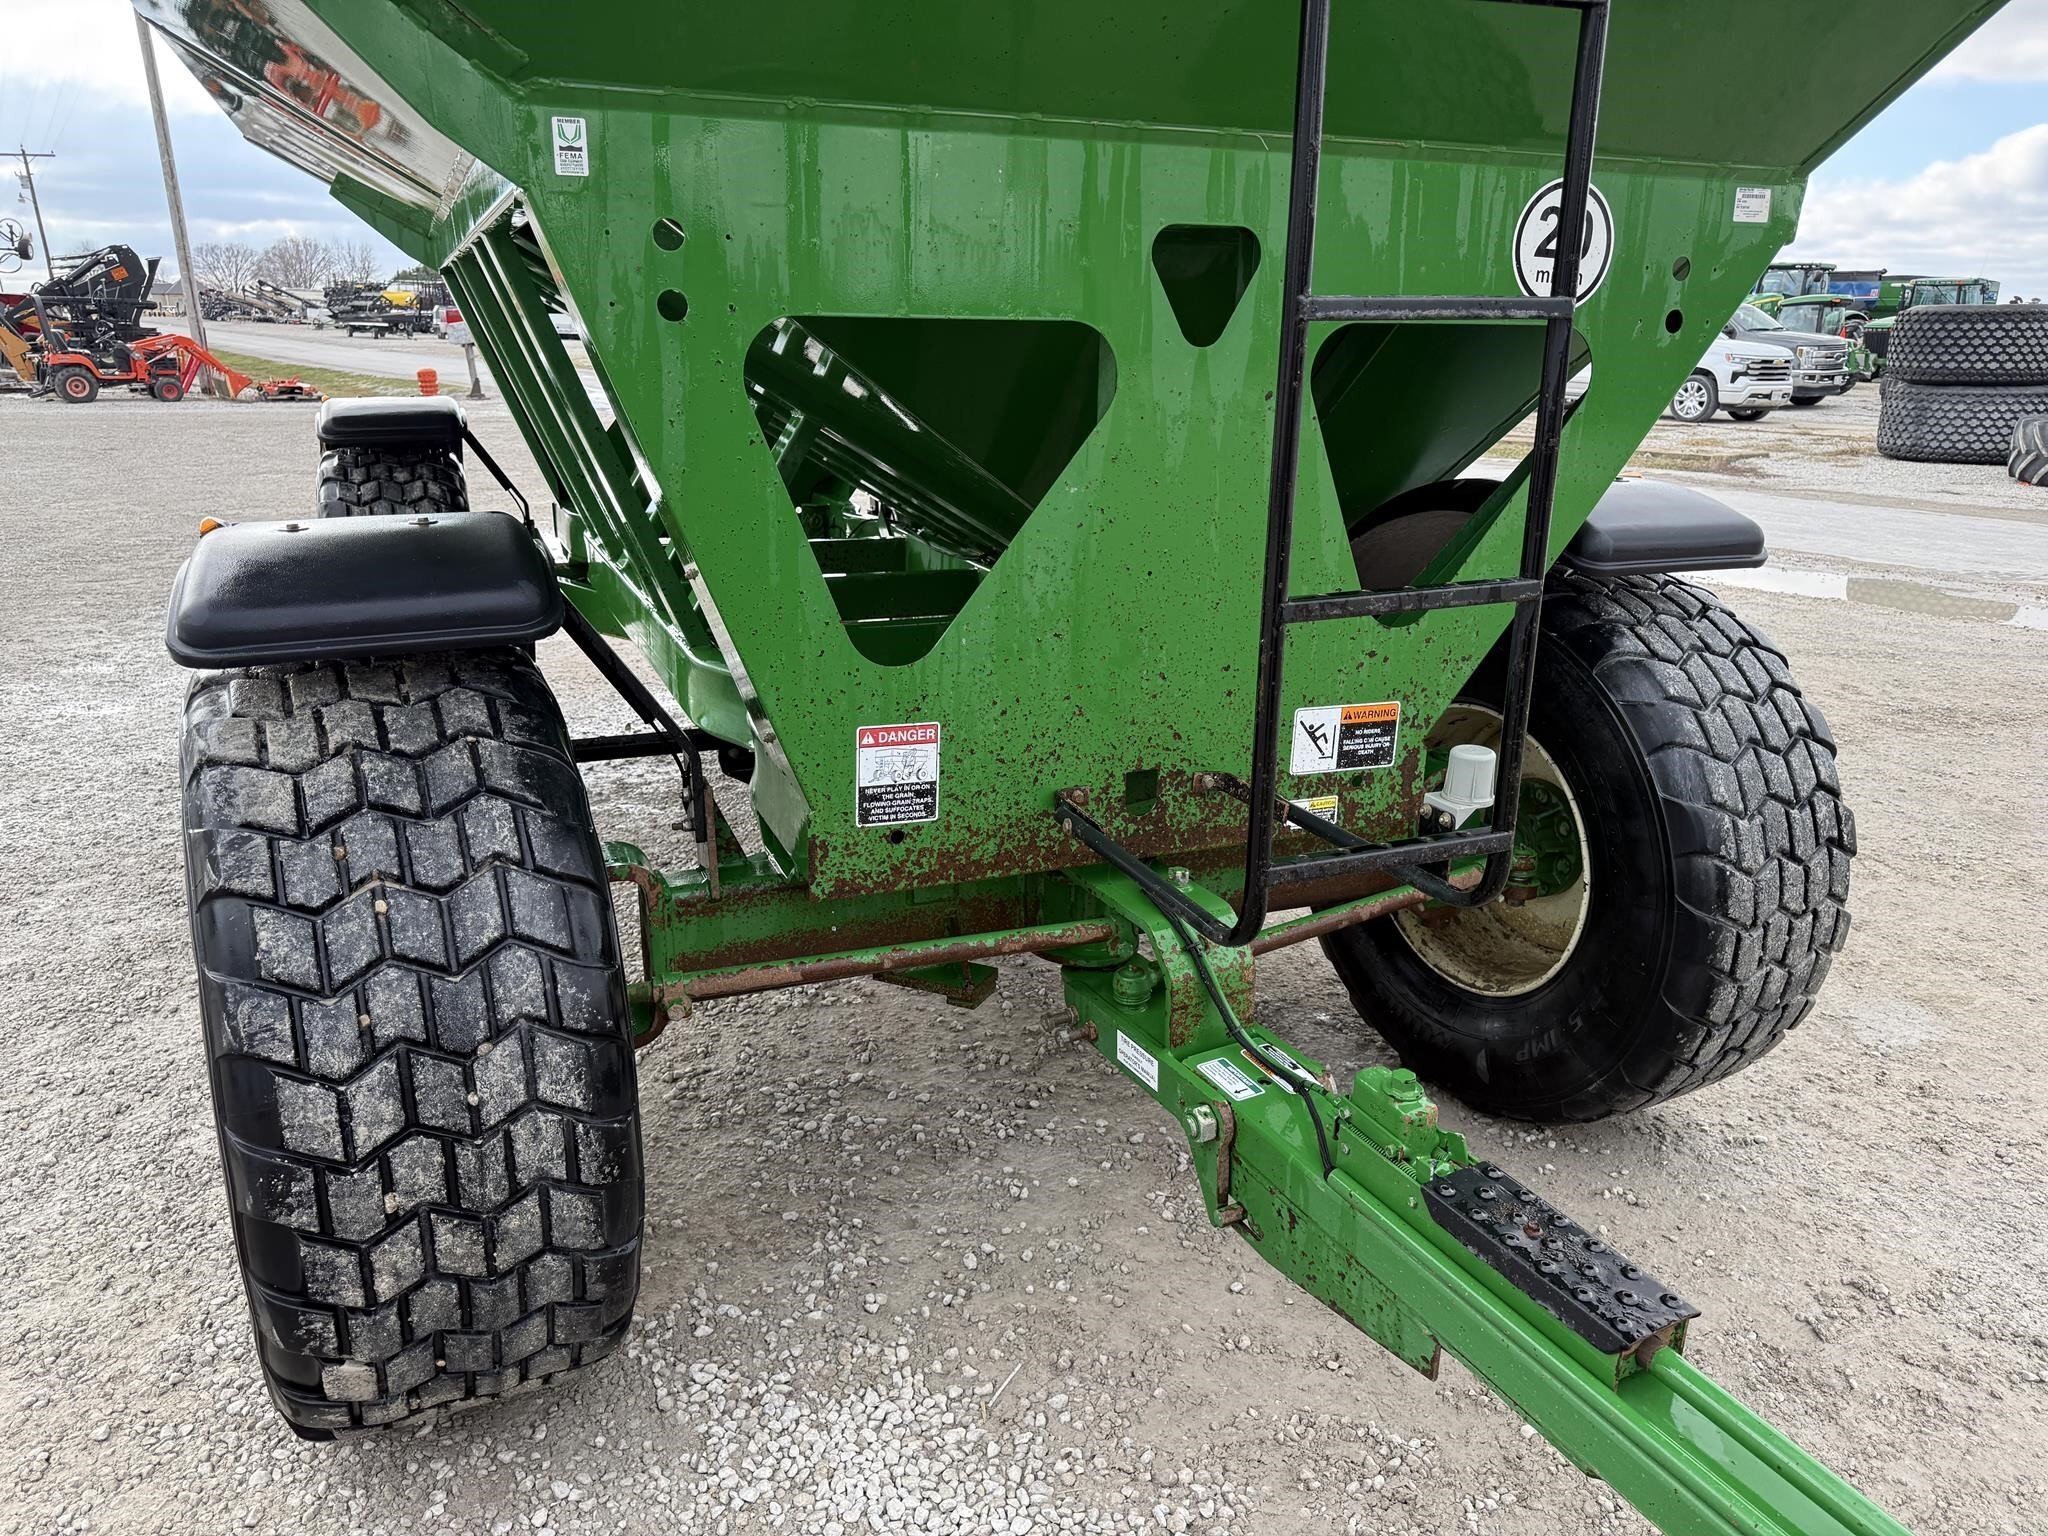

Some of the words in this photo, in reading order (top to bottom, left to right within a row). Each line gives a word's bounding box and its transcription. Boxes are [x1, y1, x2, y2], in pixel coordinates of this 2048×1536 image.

[559, 152, 583, 160] FEMA
[1353, 708, 1396, 720] WARNING
[878, 729, 936, 743] DANGER
[865, 787, 886, 795] NEVER
[881, 793, 894, 801] THE
[863, 800, 891, 808] FLOWING
[885, 804, 925, 813] SUFFOCATES
